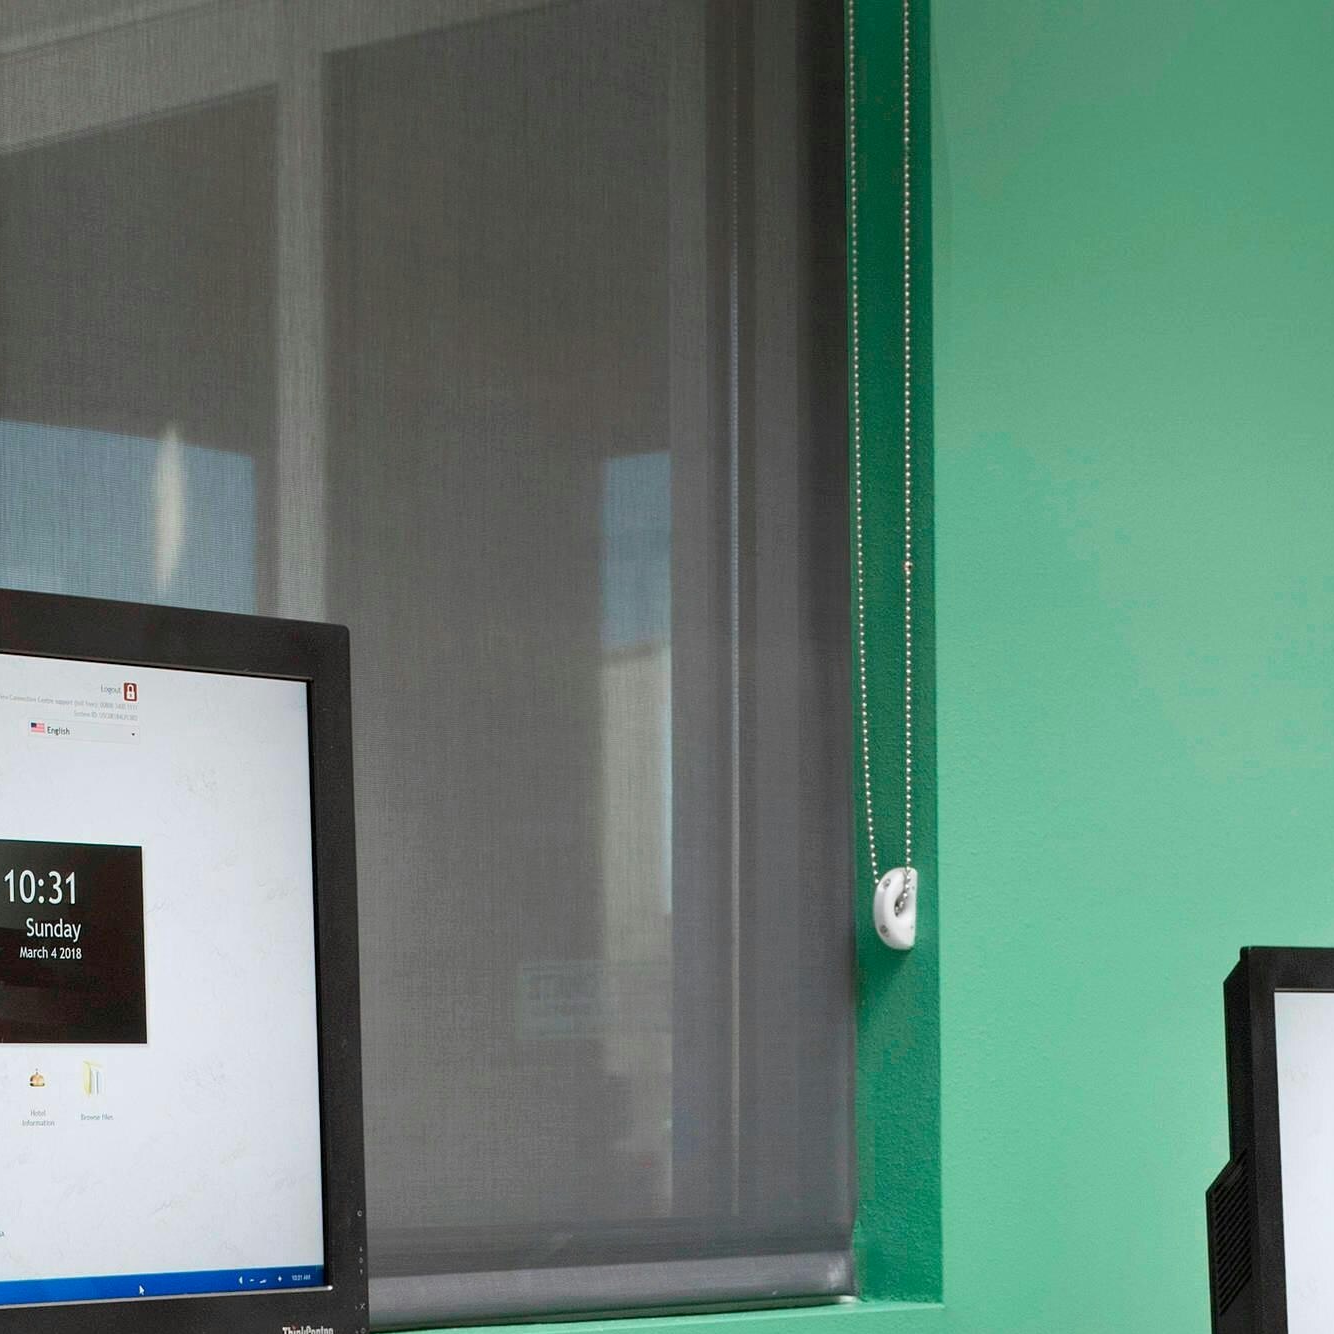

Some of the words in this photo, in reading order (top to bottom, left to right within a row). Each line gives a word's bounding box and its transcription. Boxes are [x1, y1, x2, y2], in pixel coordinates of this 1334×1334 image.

[100, 684, 121, 695] Logout
[46, 726, 71, 736] English
[4, 868, 76, 905] 10:31
[25, 917, 82, 943] Sunday
[19, 946, 49, 959] March
[50, 947, 57, 959] 4
[59, 947, 83, 960] 2018
